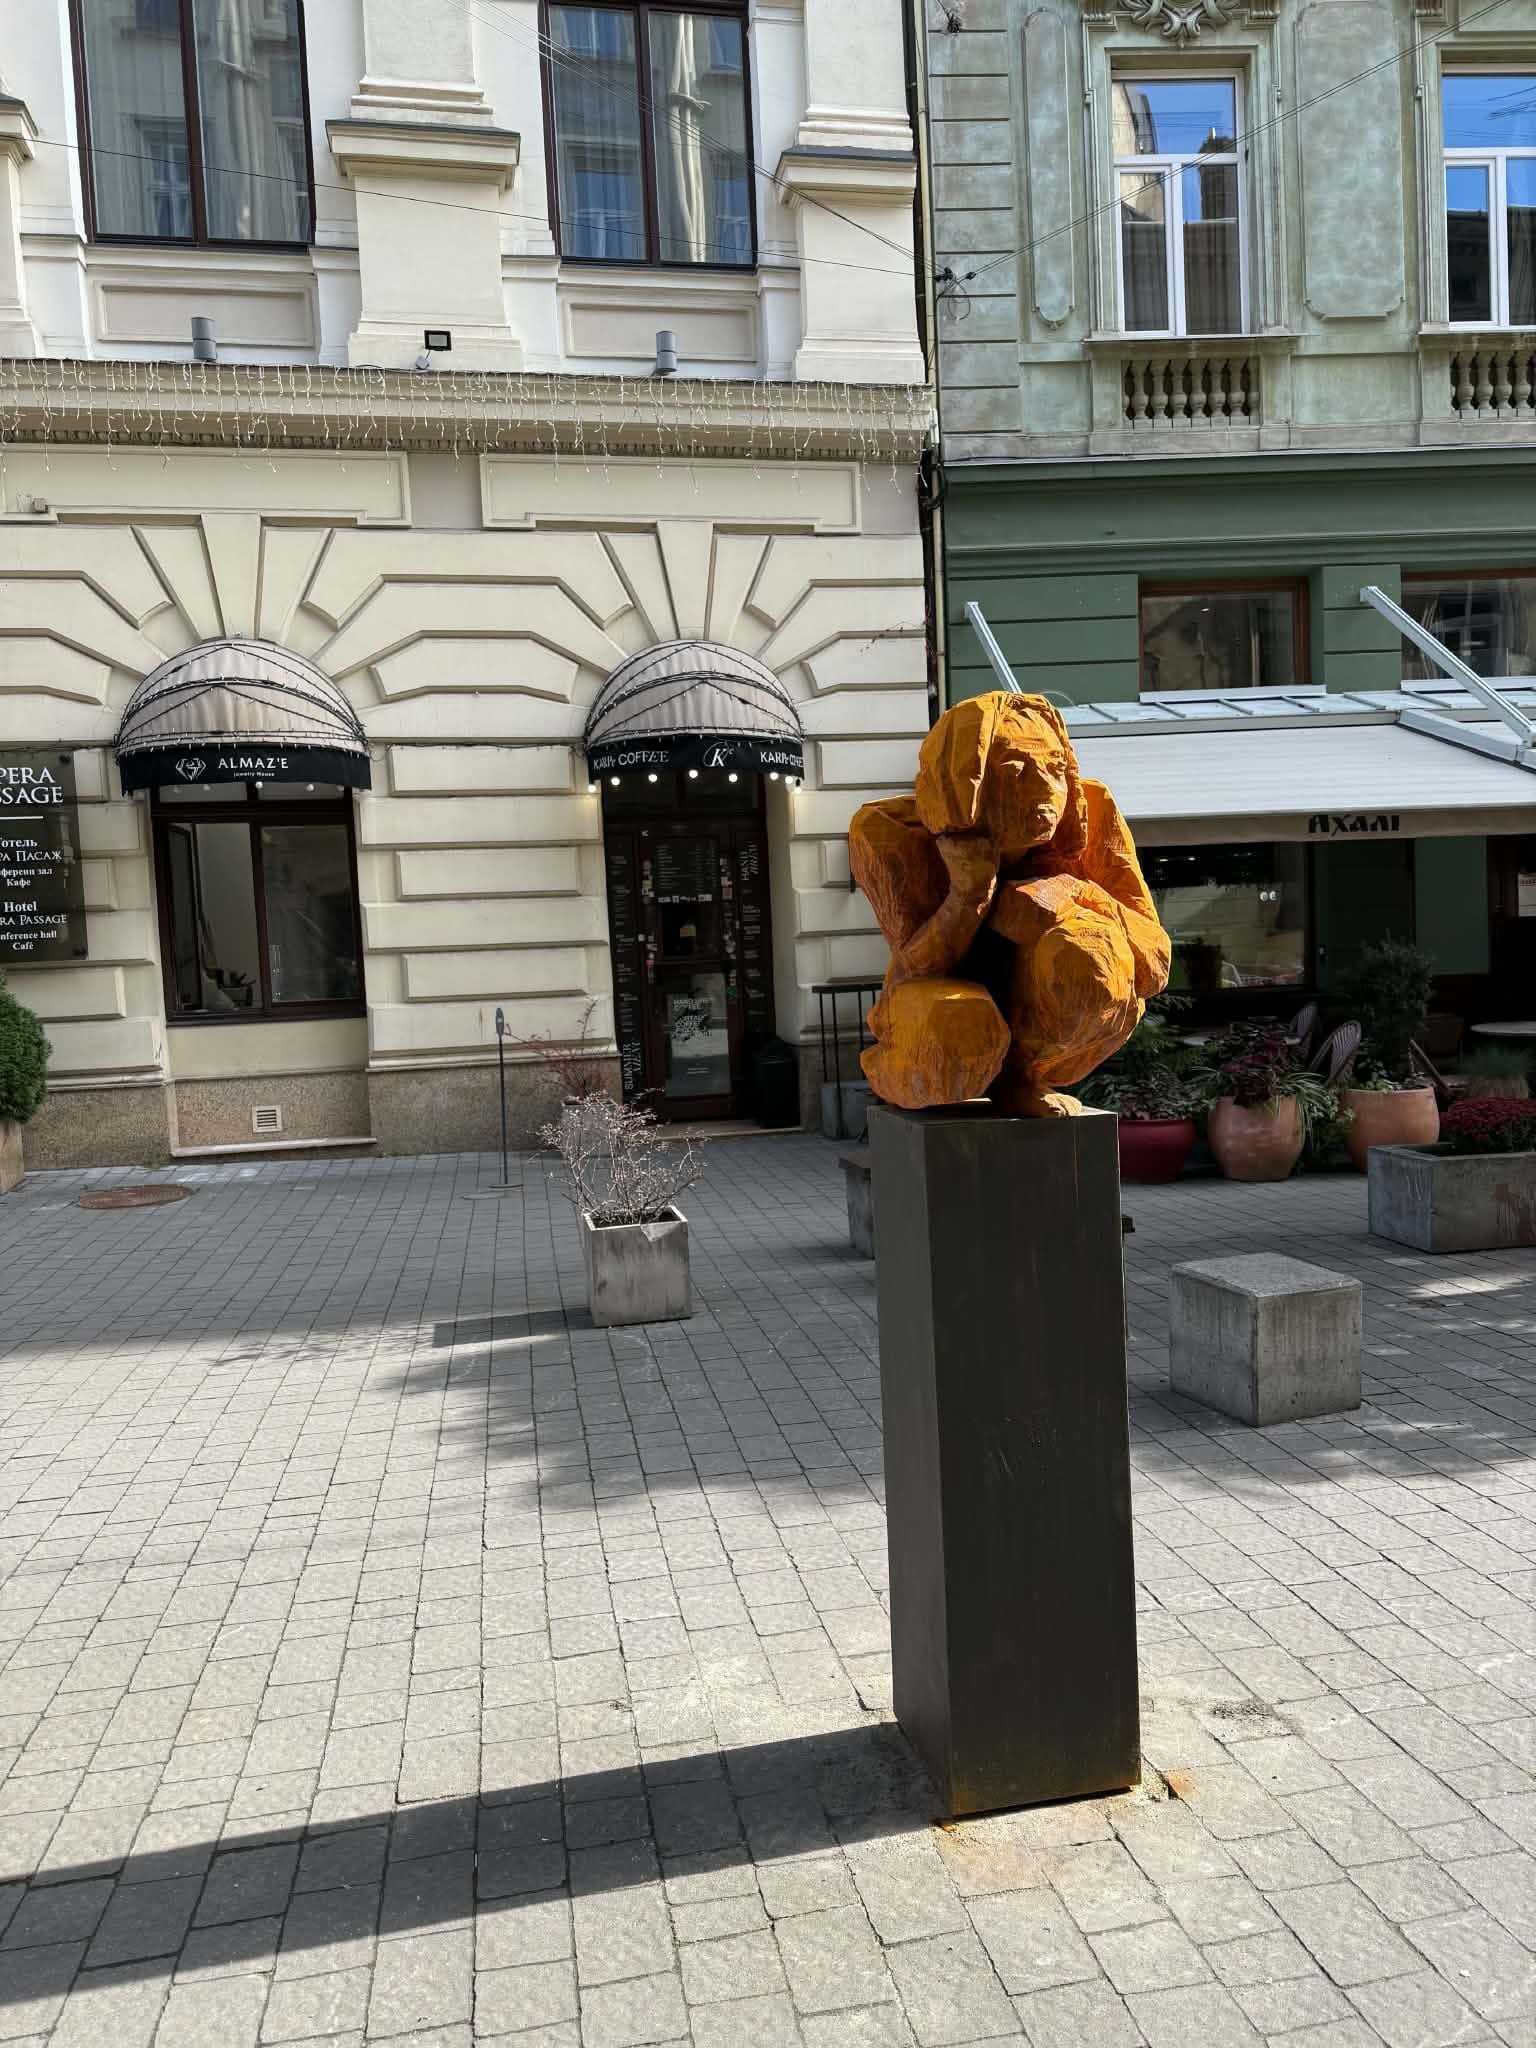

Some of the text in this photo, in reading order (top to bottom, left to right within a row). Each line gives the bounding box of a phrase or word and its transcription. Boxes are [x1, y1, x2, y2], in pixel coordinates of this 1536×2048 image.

[218, 757, 289, 769] ALMAZ'E
[618, 751, 669, 765] COFFEE
[0, 786, 64, 804] SAGE
[0, 837, 38, 848] отель
[0, 868, 36, 878] ференц
[6, 878, 31, 888] Кафе
[4, 901, 37, 912] Hotel
[18, 914, 67, 926] PASSAGE
[40, 930, 57, 939] hall
[12, 941, 34, 951] Café
